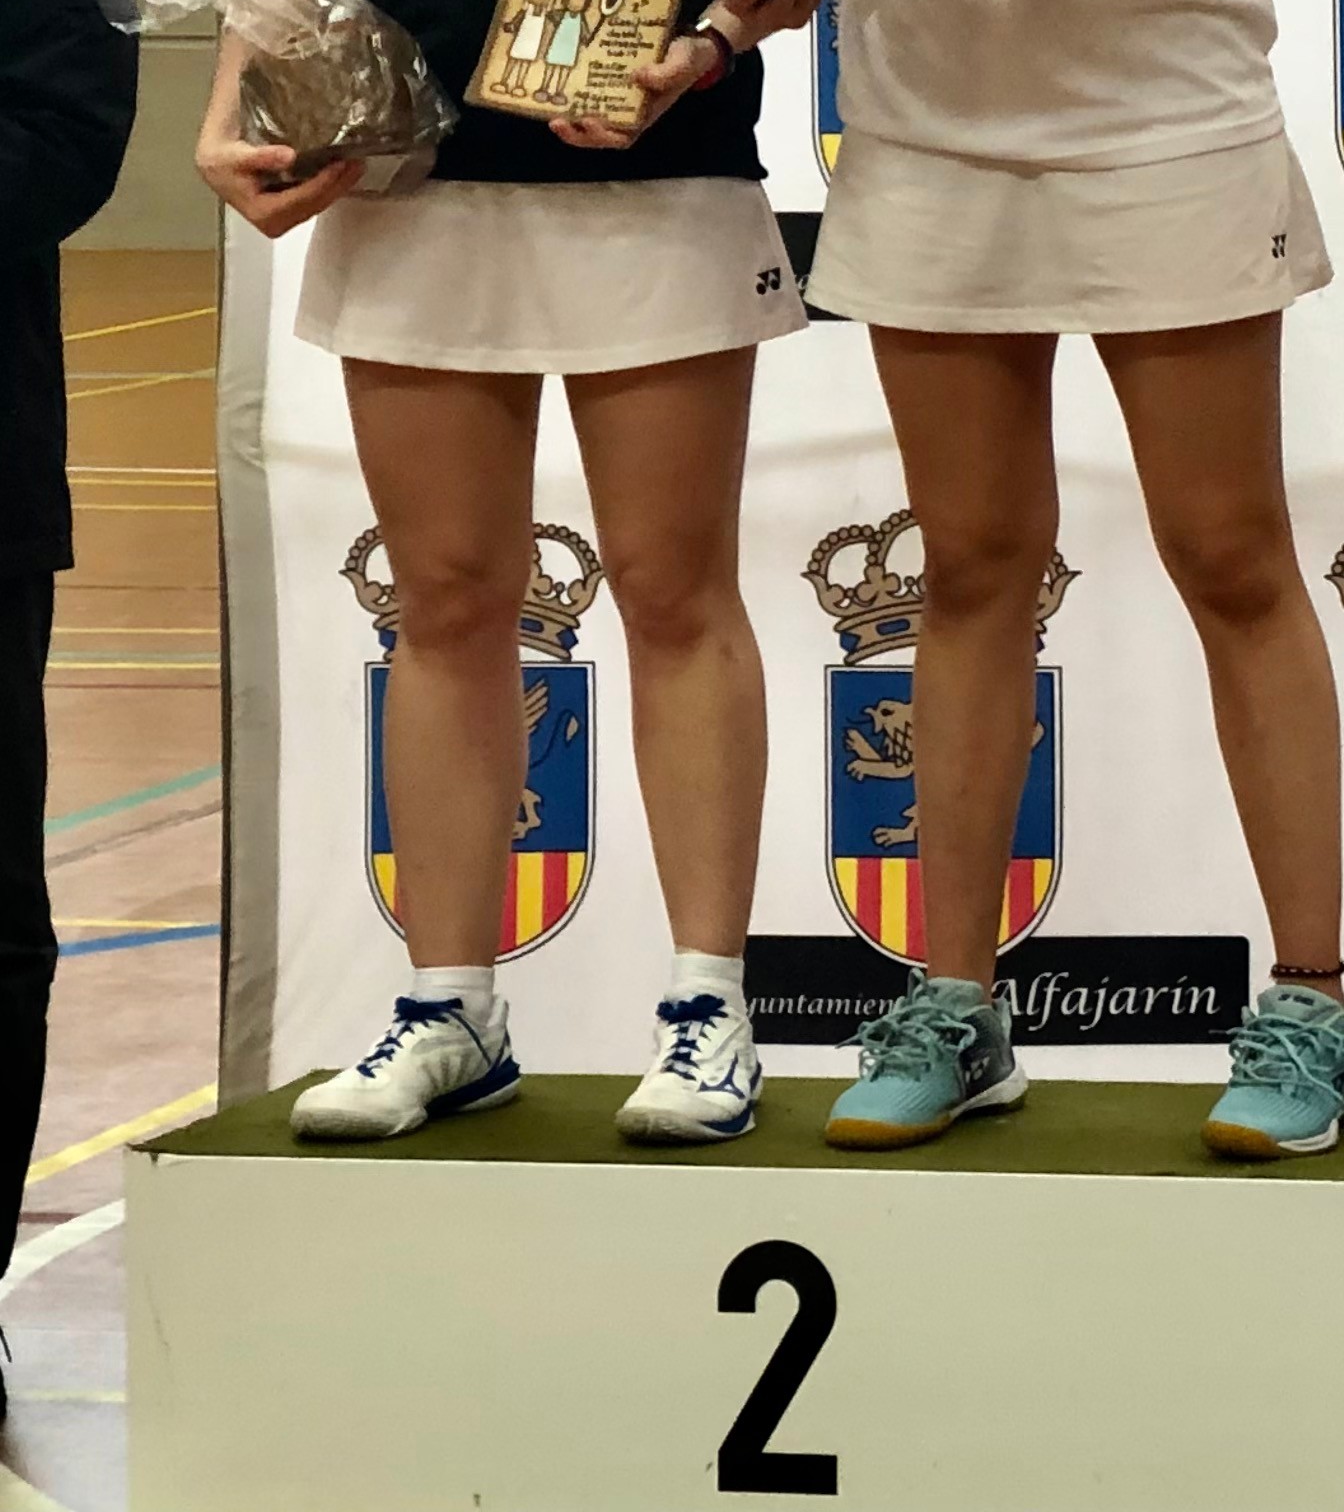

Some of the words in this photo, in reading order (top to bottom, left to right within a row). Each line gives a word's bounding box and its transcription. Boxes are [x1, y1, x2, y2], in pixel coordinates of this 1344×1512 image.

[746, 993, 897, 1019] yuntamien
[992, 971, 1221, 1032] Alfajarín
[716, 1239, 839, 1496] 2
